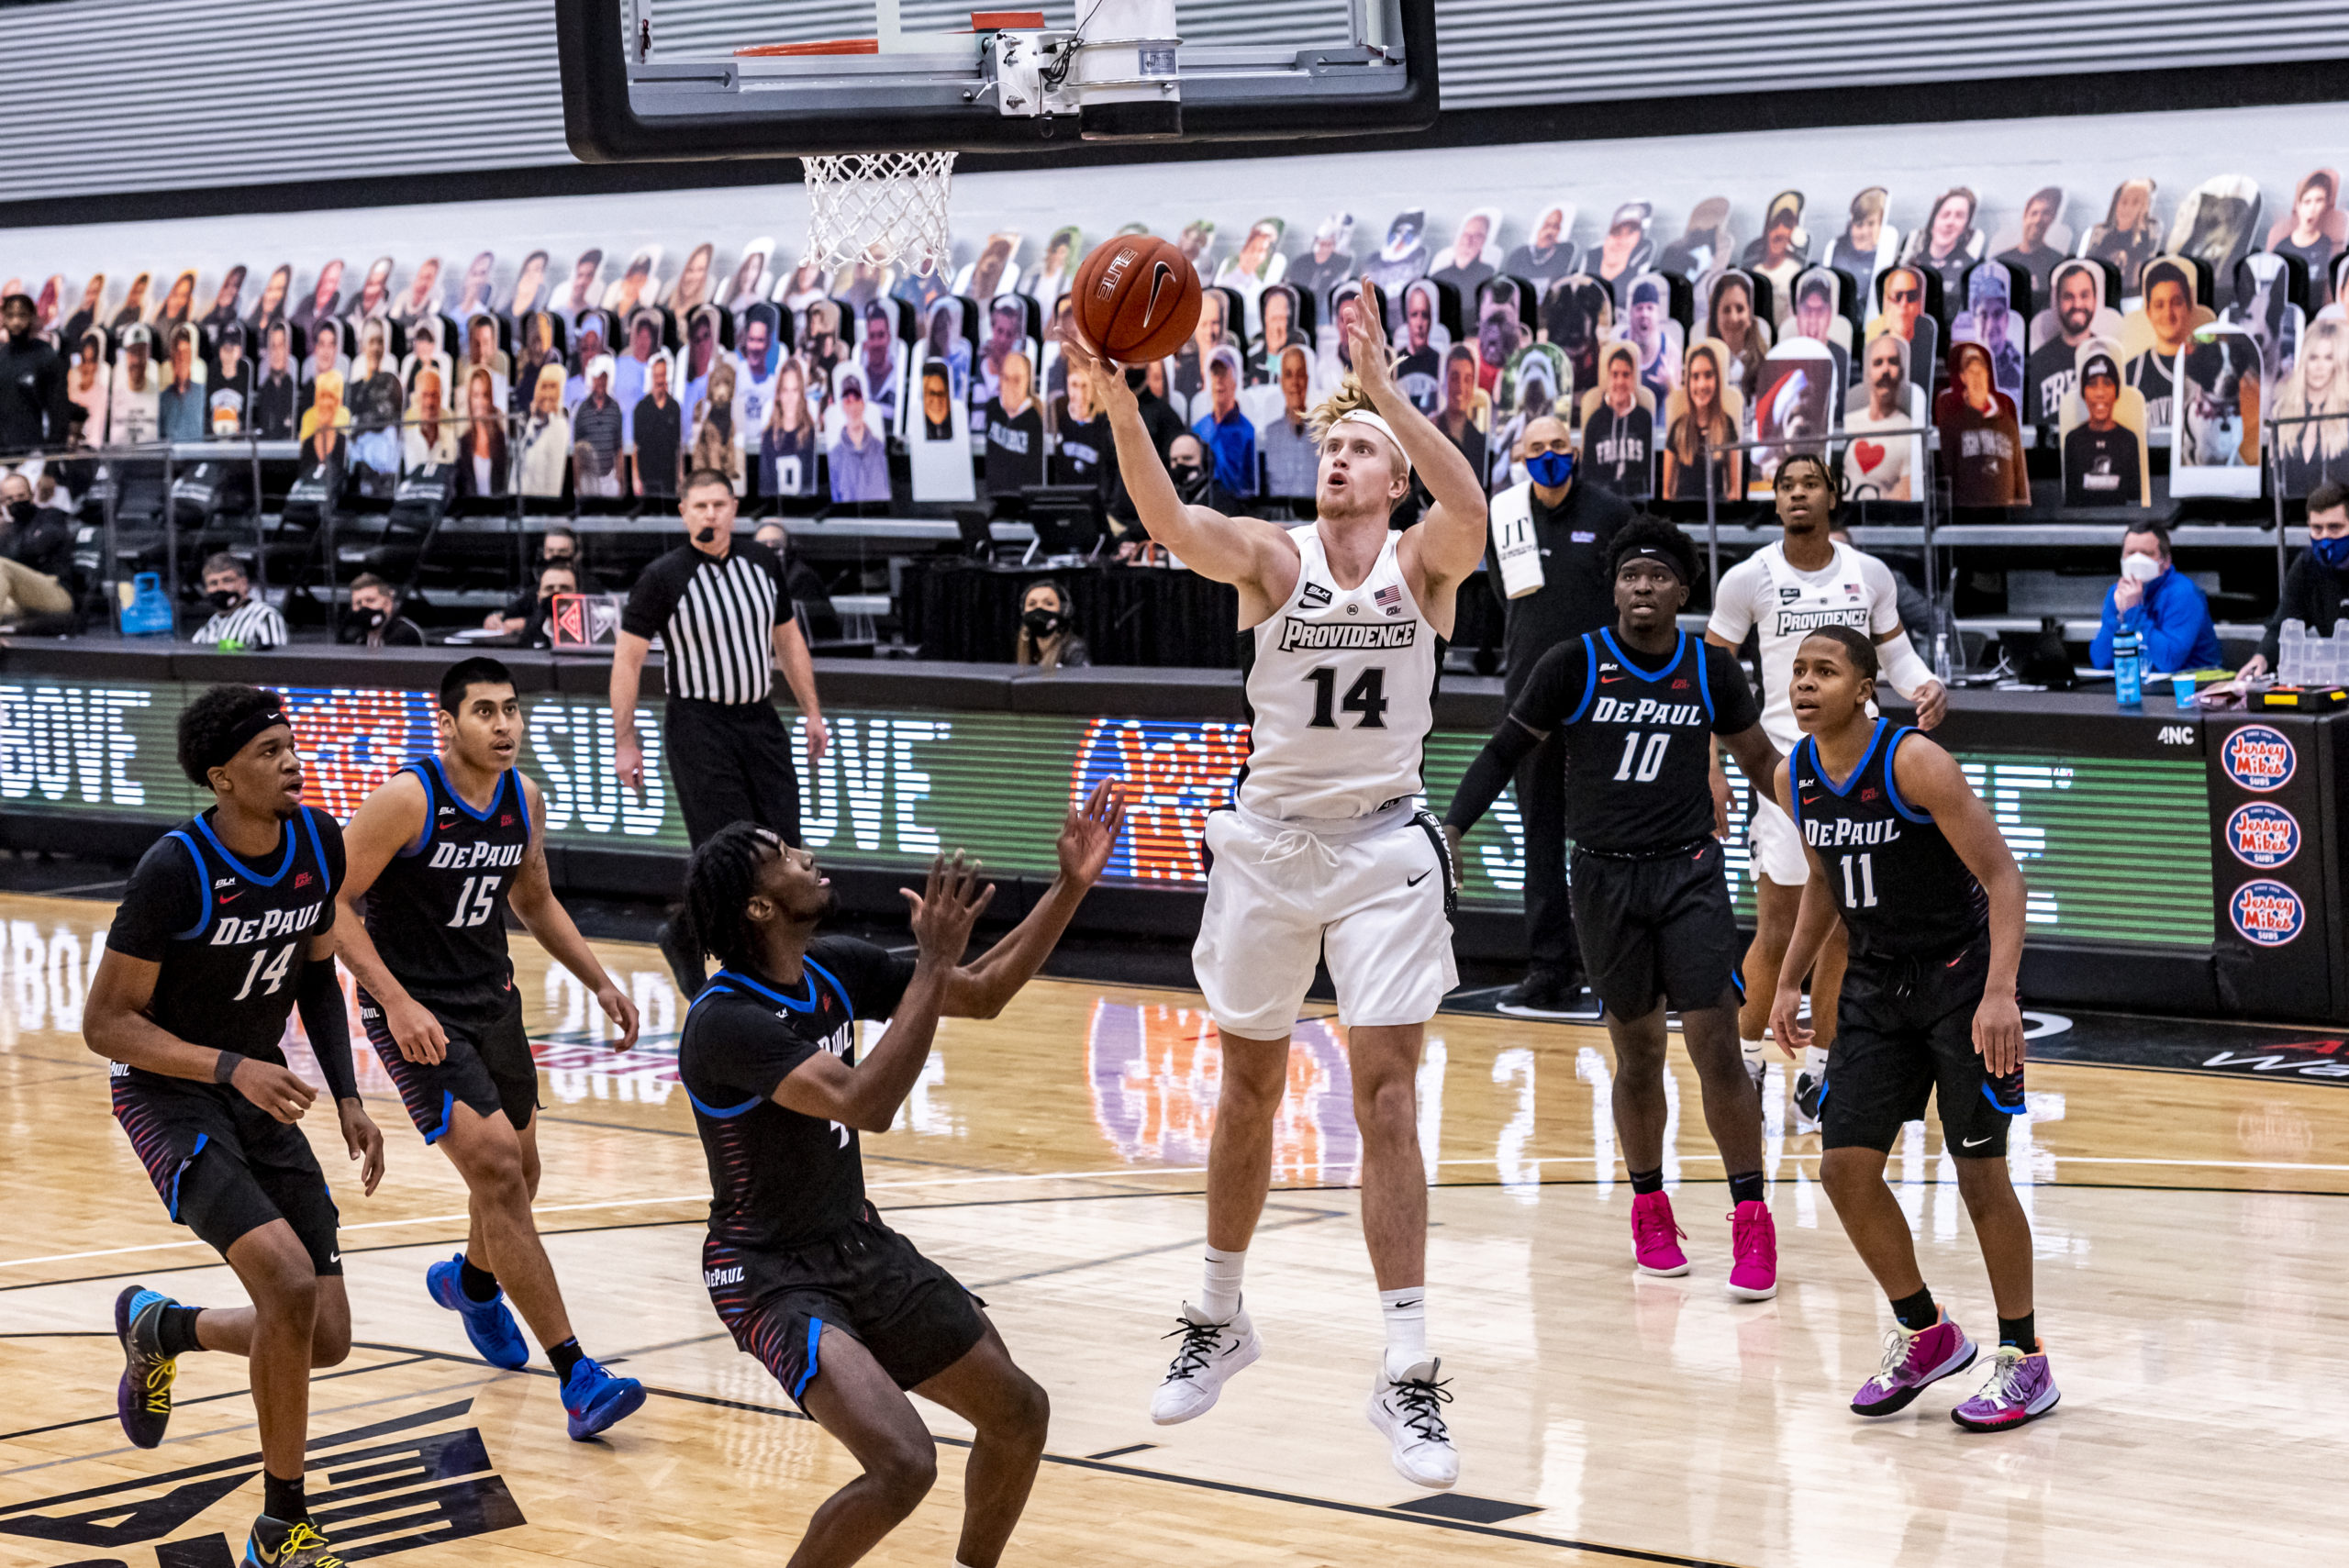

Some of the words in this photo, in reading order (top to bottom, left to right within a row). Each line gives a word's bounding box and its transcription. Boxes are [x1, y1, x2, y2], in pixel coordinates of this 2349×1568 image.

[1097, 247, 1138, 302] ELITE
[1308, 585, 1330, 600] BLM
[1278, 617, 1417, 652] PROVIDENCE
[1776, 609, 1867, 636] PROVIDENCE
[1301, 665, 1390, 730] 14
[1613, 731, 1671, 782] 10
[2232, 736, 2285, 761] Jersey
[2249, 777, 2270, 786] SUBS
[2237, 813, 2289, 837] Jersey
[2254, 854, 2275, 863] SUBS
[215, 877, 236, 887] BLM
[1841, 853, 1878, 908] 11
[446, 875, 502, 928] 15
[2242, 892, 2293, 916] Jersey
[2257, 931, 2278, 940] SUBS
[233, 941, 296, 1001] 14
